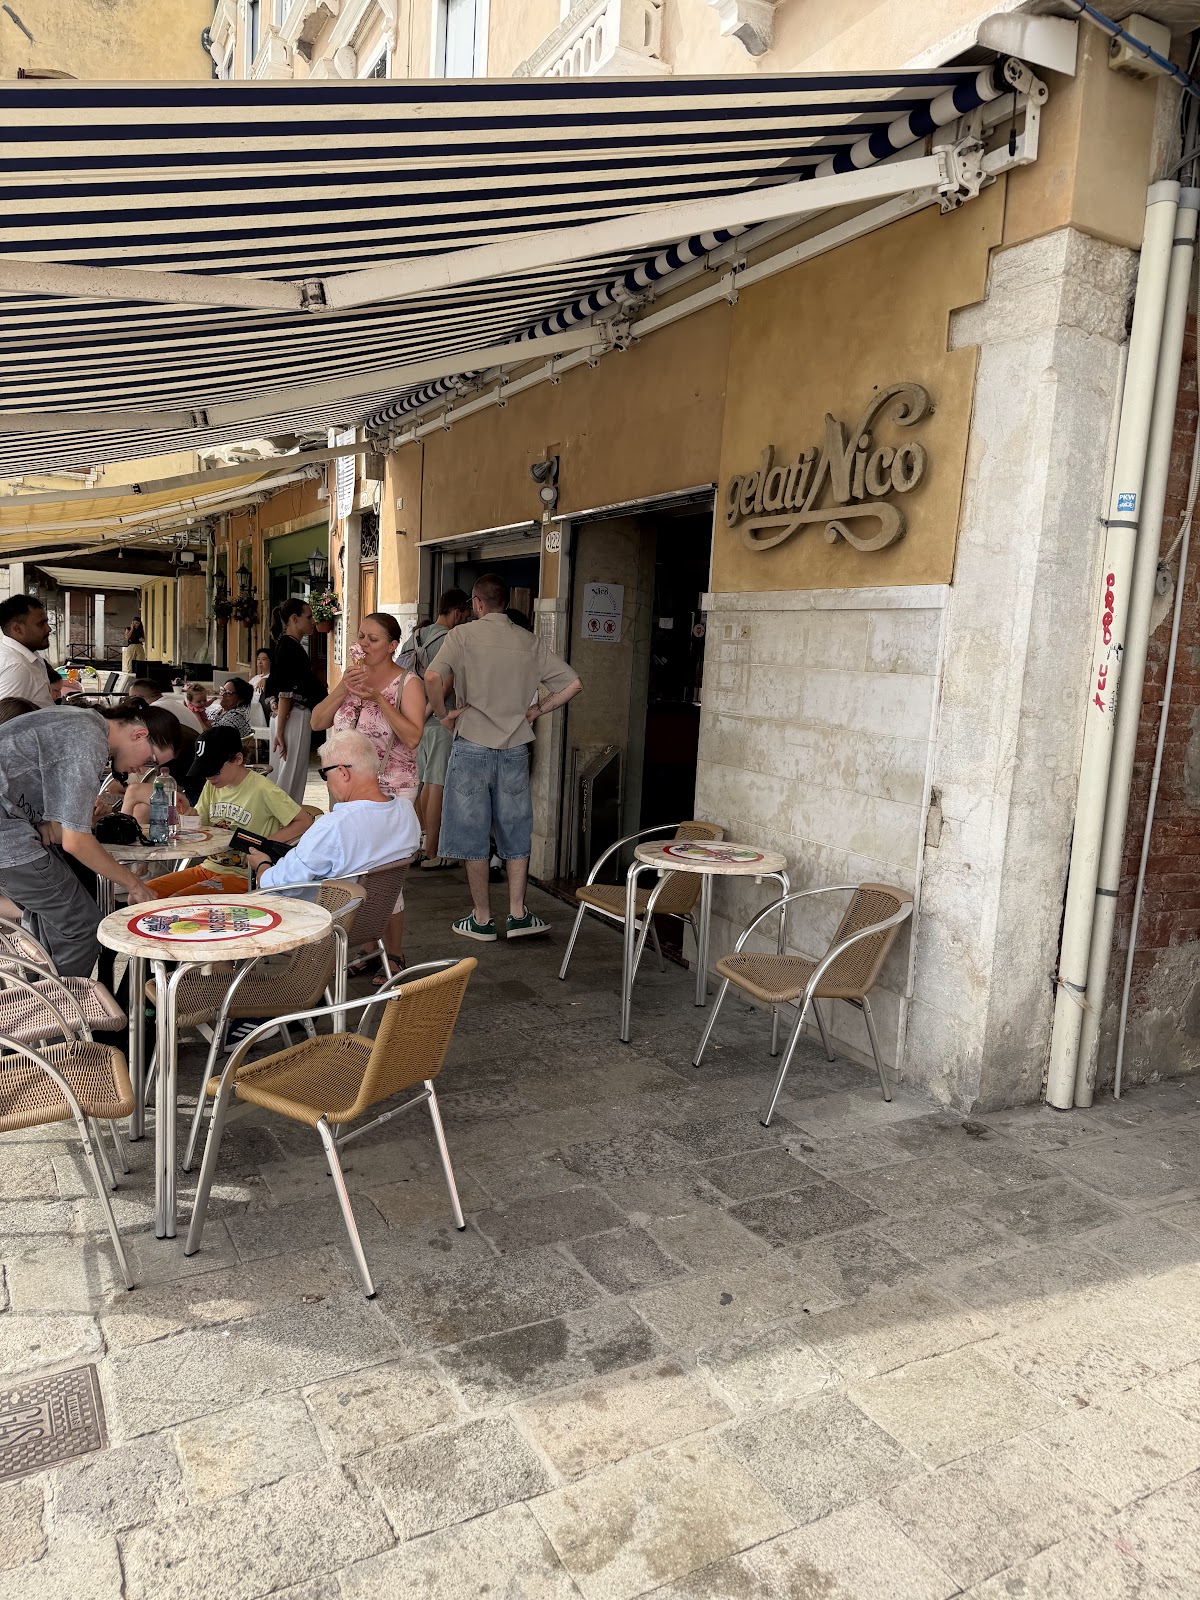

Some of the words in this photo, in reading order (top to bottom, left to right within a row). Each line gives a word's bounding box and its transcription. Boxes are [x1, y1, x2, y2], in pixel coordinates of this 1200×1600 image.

[724, 444, 818, 528] gelati
[208, 909, 226, 923] SELF
[232, 908, 251, 932] SERVICE
[208, 924, 226, 933] NO
